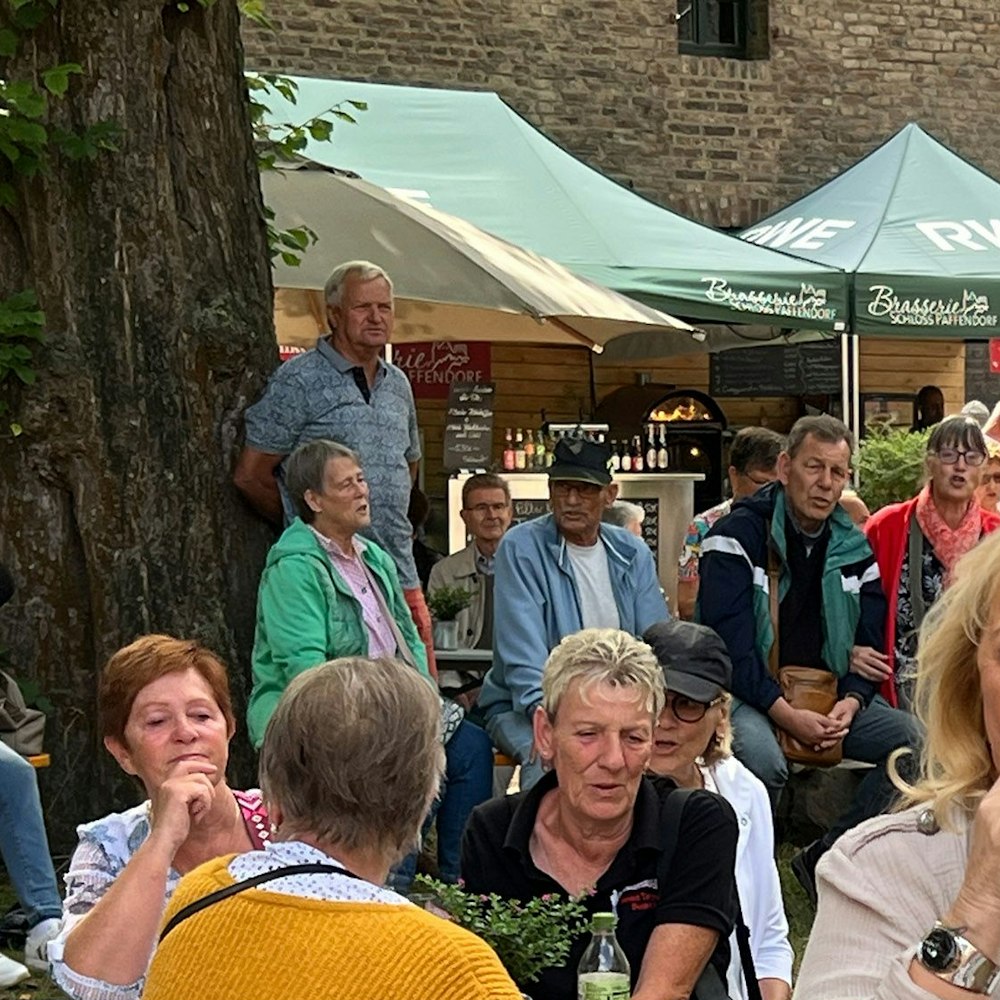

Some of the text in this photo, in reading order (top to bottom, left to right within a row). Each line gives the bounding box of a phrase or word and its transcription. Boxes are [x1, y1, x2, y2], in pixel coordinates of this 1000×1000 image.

[701, 277, 800, 306] Brasserie
[868, 285, 961, 316] Brasserie
[889, 311, 998, 326] SCHLOSS PAFFENDORF
[408, 369, 483, 384] FFENDORF
